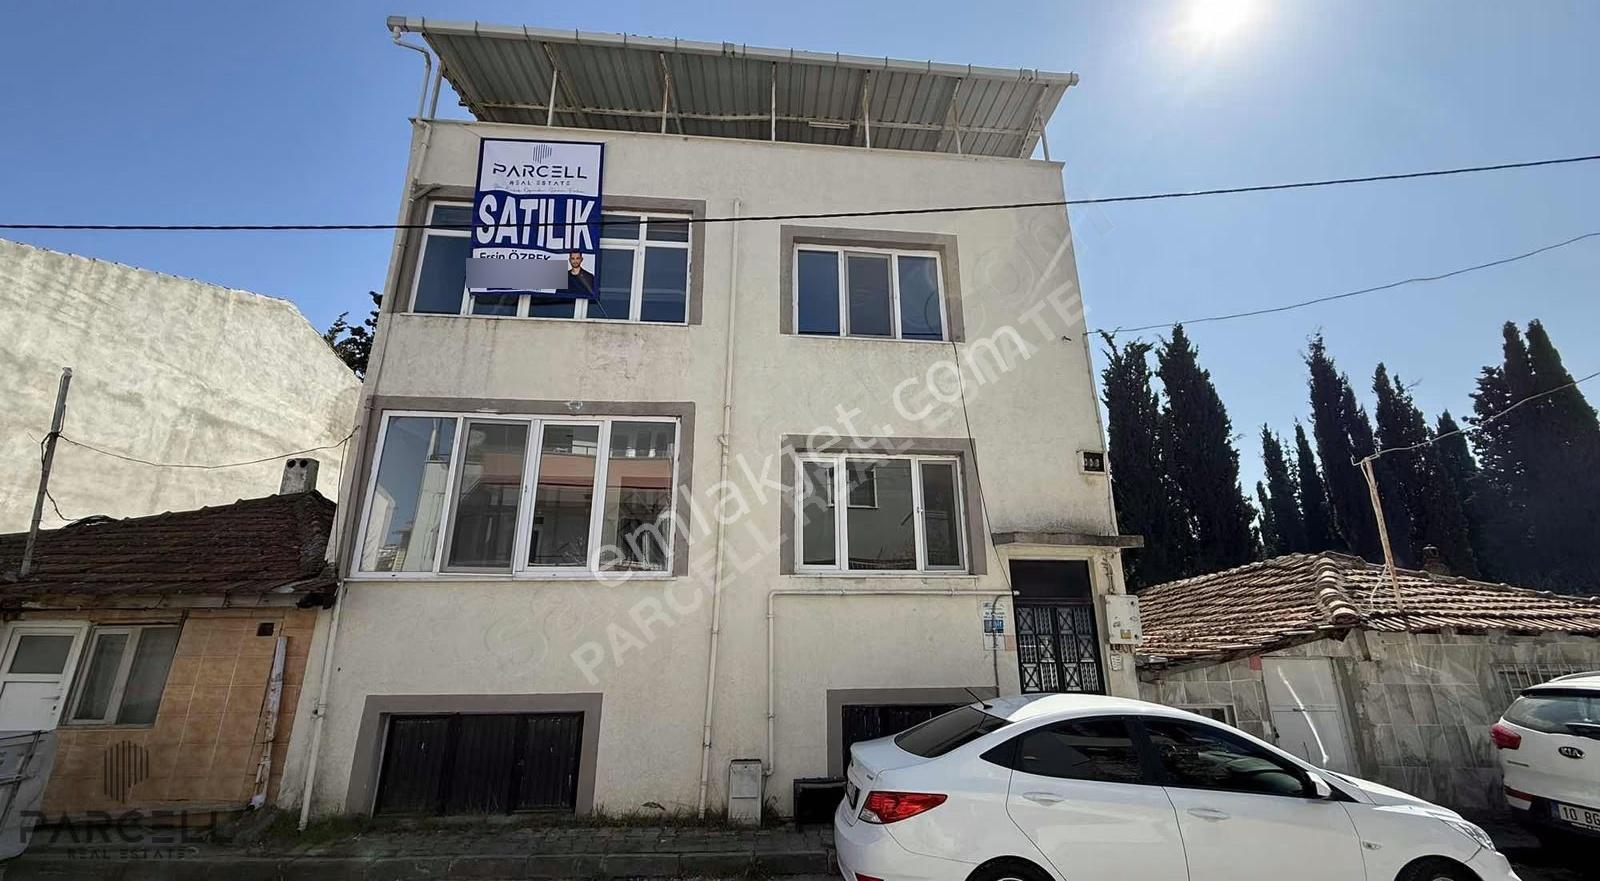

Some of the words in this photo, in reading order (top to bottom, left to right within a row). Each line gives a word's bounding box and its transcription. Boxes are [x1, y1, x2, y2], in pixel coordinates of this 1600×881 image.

[492, 163, 588, 179] PARCELL
[476, 194, 595, 250] SATILIK
[1561, 746, 1582, 758] KIA
[1563, 806, 1578, 821] 10
